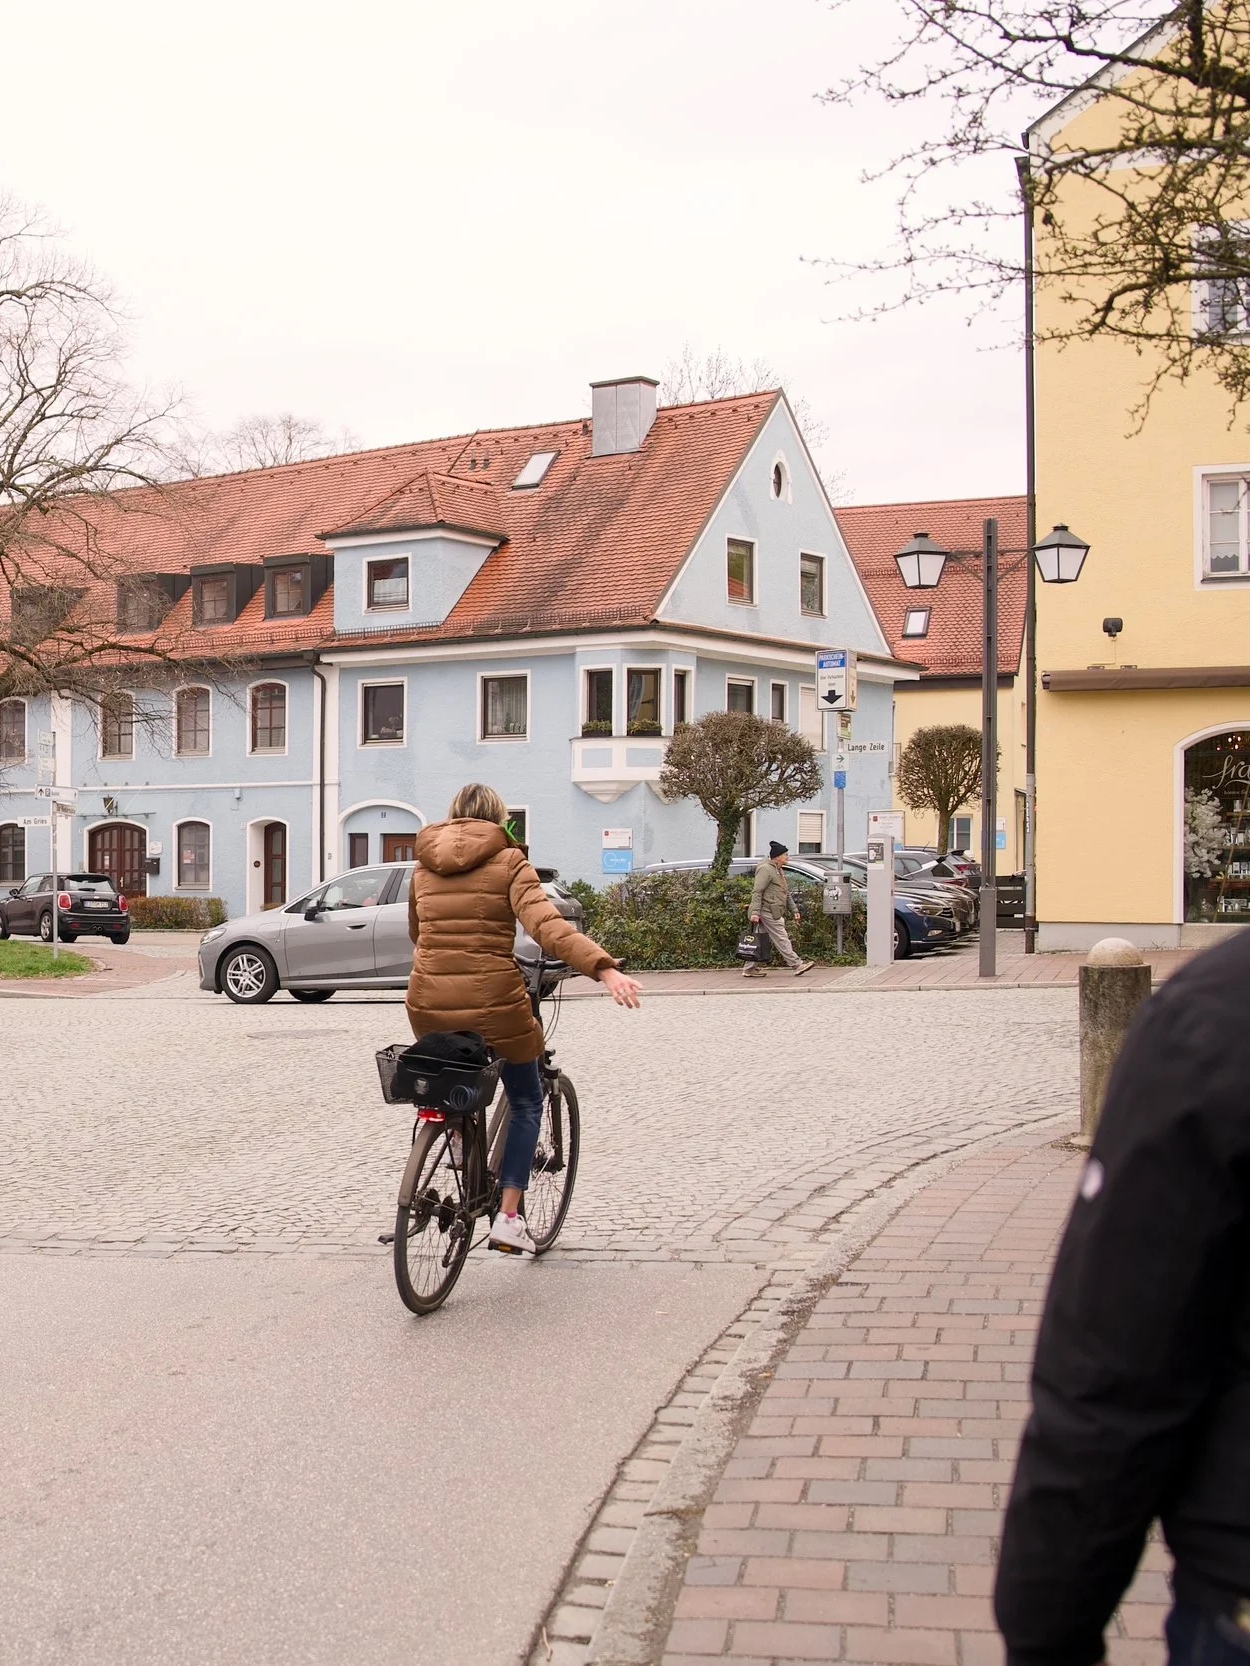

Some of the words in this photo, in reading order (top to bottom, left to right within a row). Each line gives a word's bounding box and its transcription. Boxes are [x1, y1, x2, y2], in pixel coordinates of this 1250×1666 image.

[847, 743, 867, 753] Lange
[869, 742, 885, 751] Zeile
[33, 817, 48, 825] Gries
